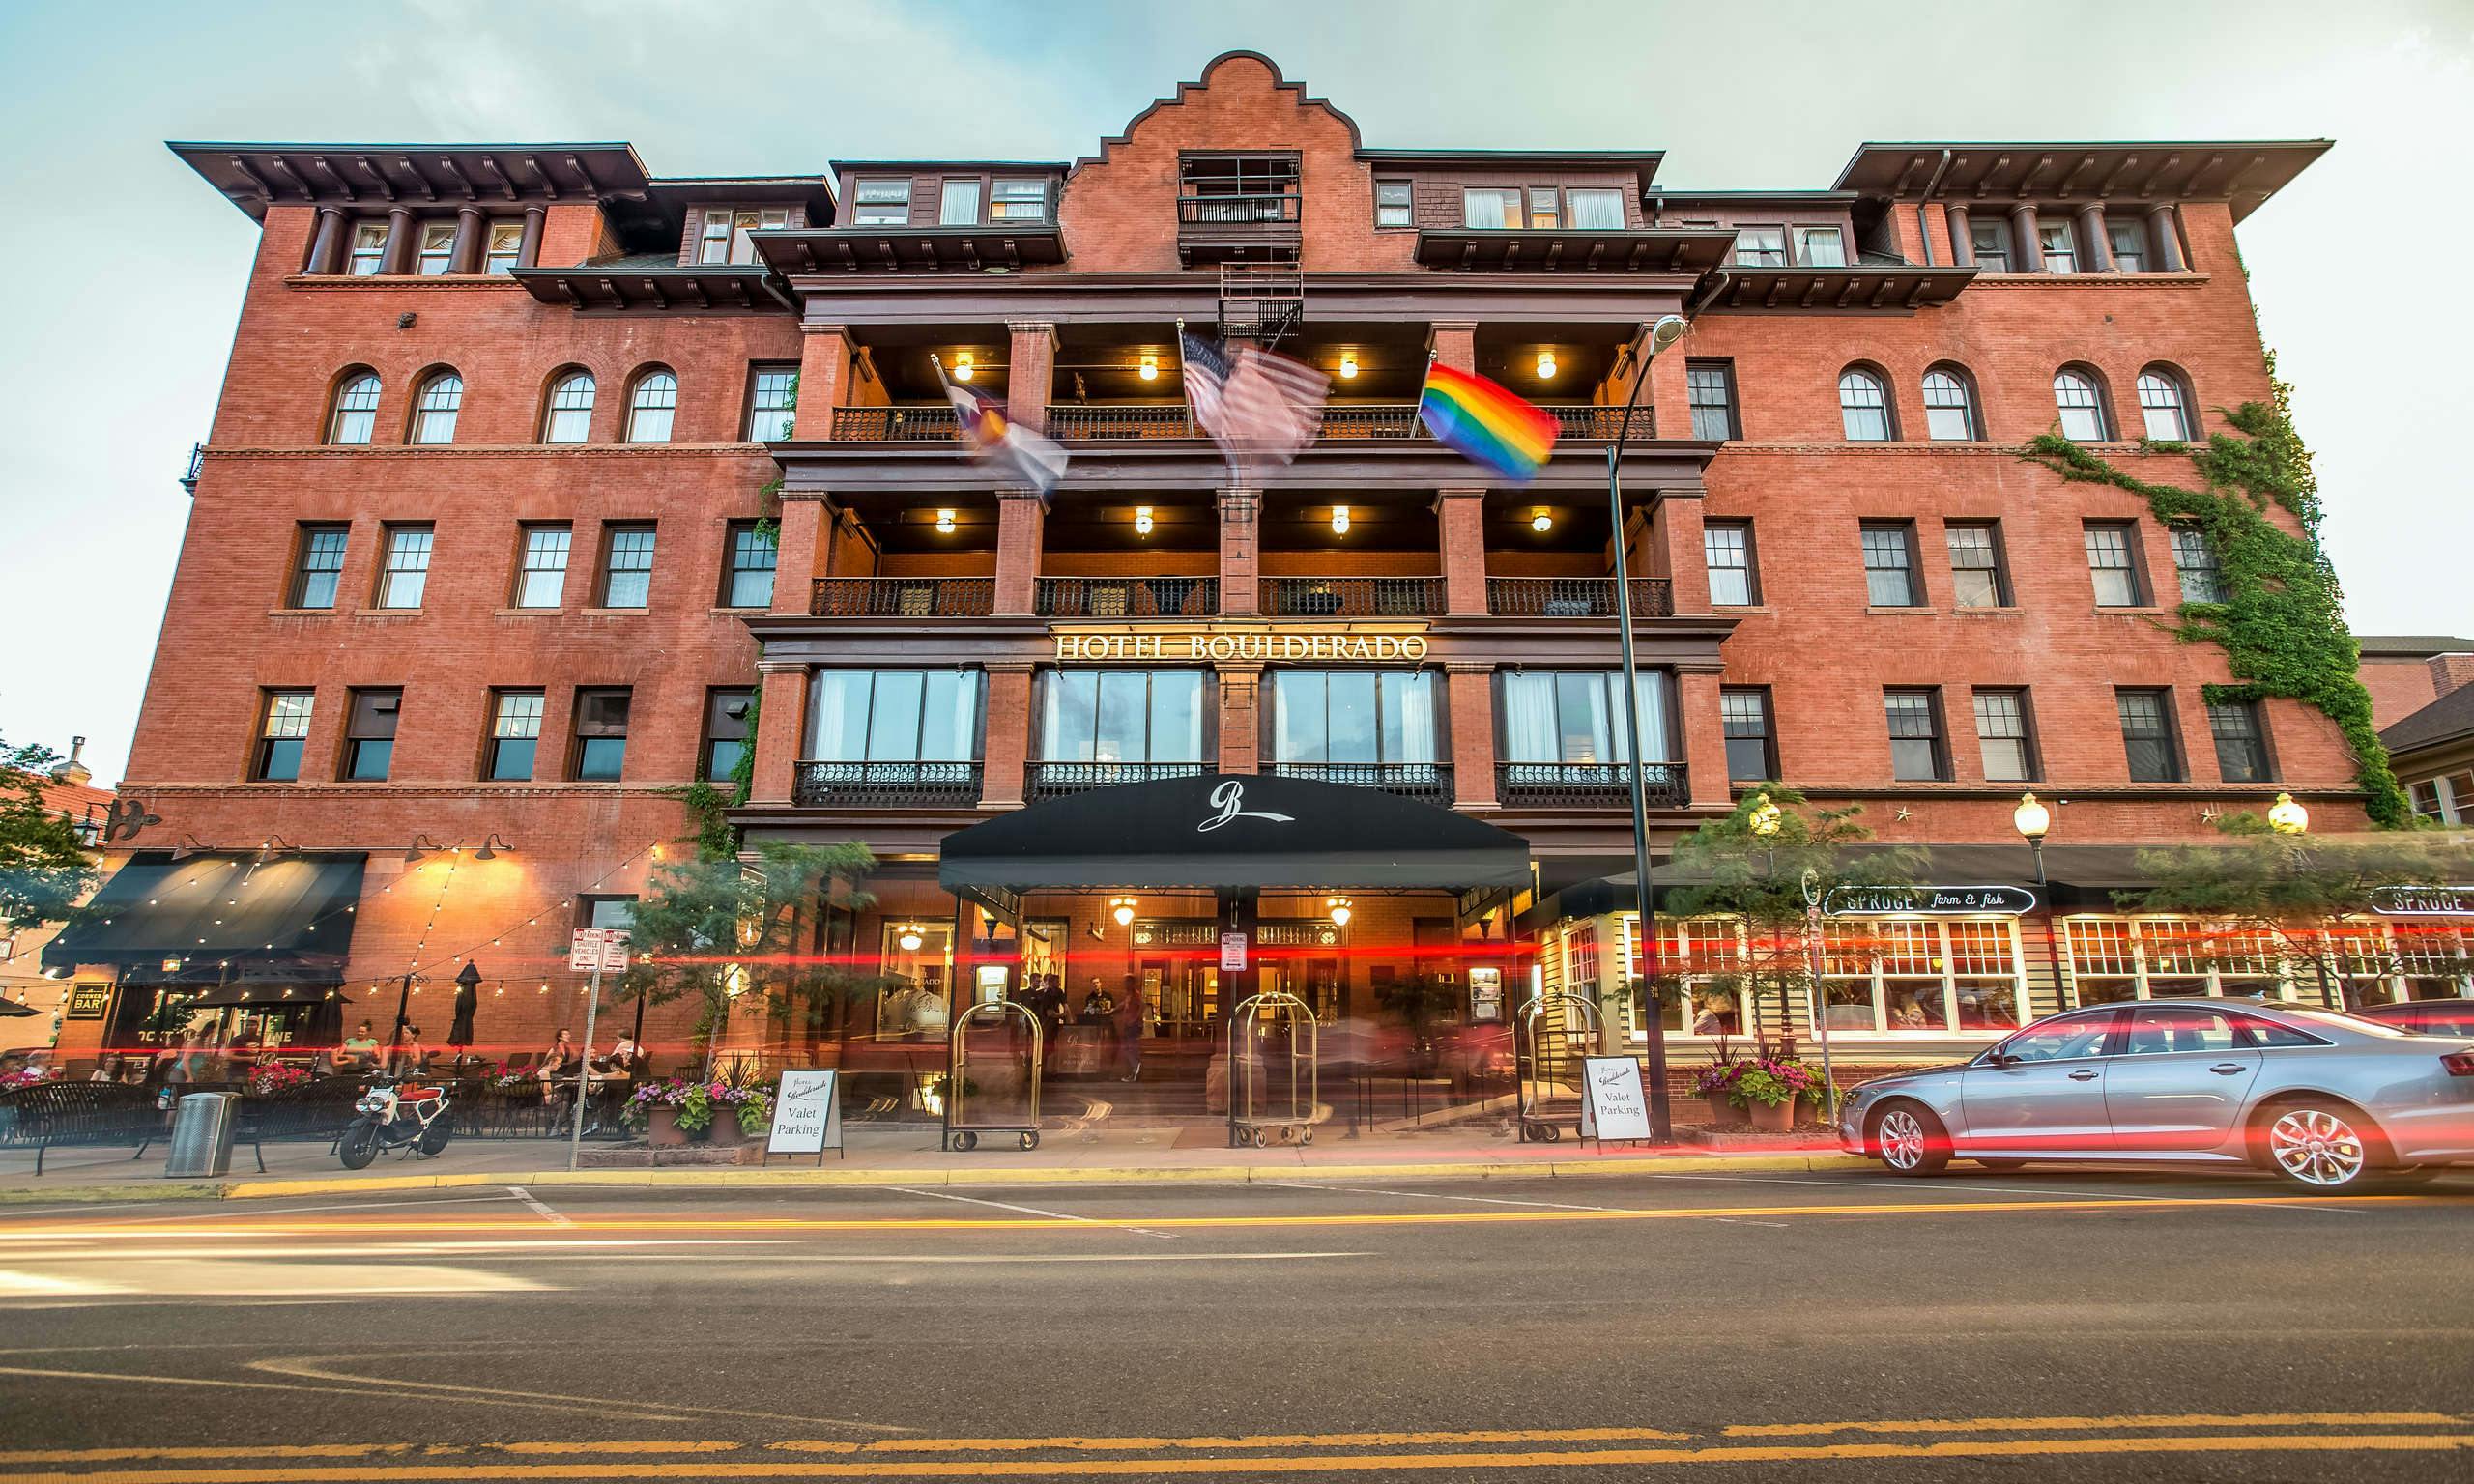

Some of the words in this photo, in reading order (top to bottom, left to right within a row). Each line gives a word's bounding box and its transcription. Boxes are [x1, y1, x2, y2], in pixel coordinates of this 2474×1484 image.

[1055, 636, 1168, 659] HOTEL
[1190, 635, 1429, 660] BOULDERADO
[1931, 894, 1961, 908] farm
[1965, 894, 1976, 905] &
[1980, 893, 2005, 909] fish
[2393, 891, 2464, 910] SPRUCE
[74, 999, 100, 1009] BAR
[1605, 1093, 1631, 1101] Valet
[789, 1107, 817, 1119] Valet
[1600, 1105, 1641, 1117] Parking
[777, 1124, 820, 1137] Parking
